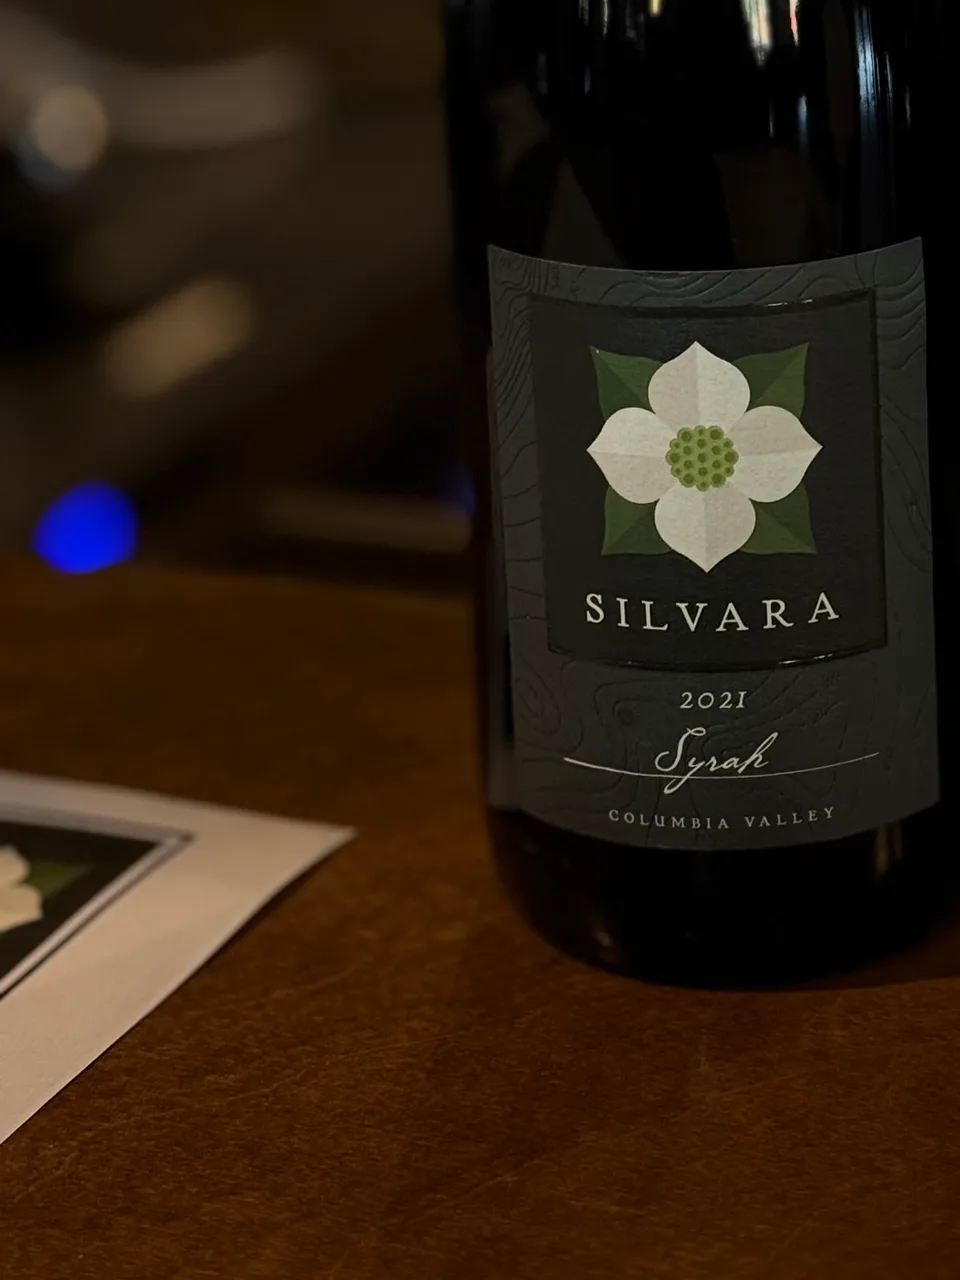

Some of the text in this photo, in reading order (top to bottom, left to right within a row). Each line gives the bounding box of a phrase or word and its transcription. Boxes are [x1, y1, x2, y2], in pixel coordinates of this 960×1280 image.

[585, 592, 840, 632] SILVARA
[679, 691, 748, 710] 2021
[654, 726, 779, 795] Syrah
[608, 806, 835, 830] COLUMBIA VALLEY
